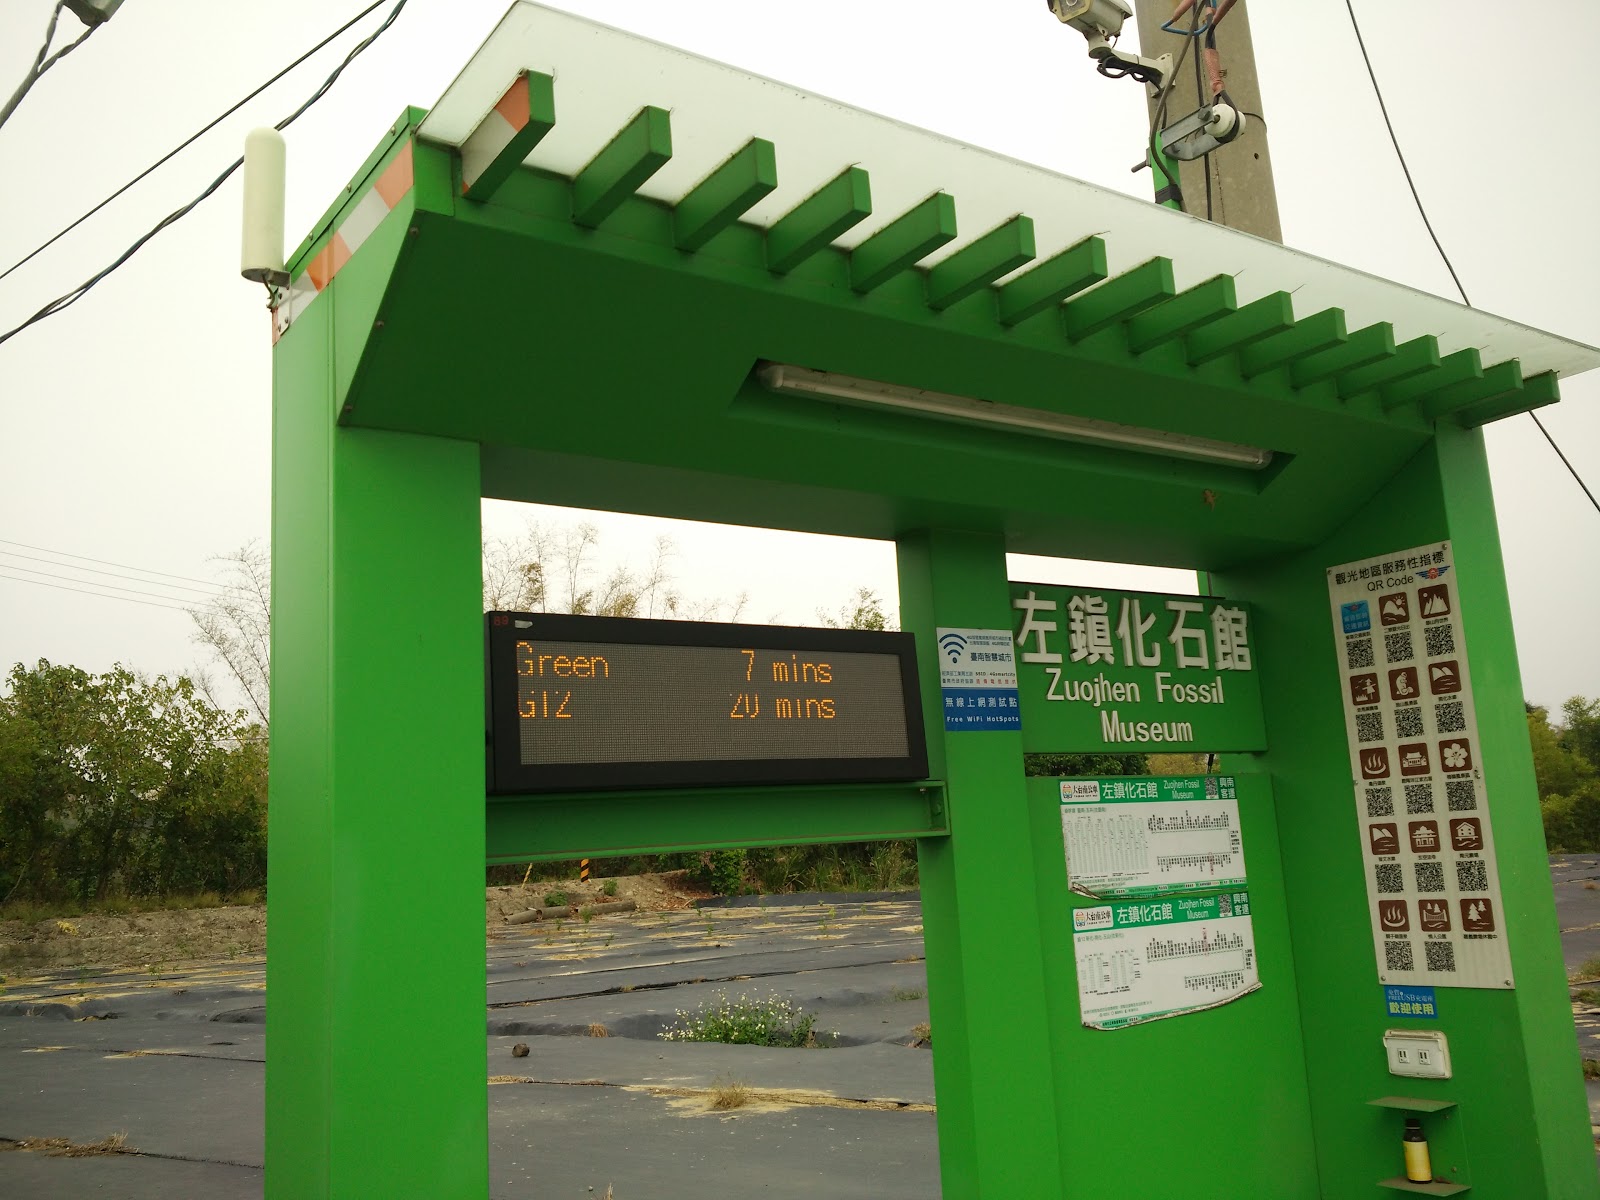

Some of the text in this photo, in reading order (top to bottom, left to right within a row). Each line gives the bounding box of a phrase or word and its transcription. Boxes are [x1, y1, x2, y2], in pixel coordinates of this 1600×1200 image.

[1335, 551, 1445, 585] 觀光地區服務性指標
[1367, 575, 1414, 592] QR Code
[1013, 590, 1252, 670] 左鎮化石館
[517, 642, 832, 682] Green 7 mins
[970, 652, 1012, 662] 臺南智慧城市
[1045, 668, 1224, 707] Zuojhen Fossil
[776, 698, 836, 718] mins
[945, 697, 1017, 708] 無線上網測試點
[1101, 710, 1193, 743] Museum
[1102, 782, 1158, 799] 左鎮化石館
[1163, 780, 1200, 792] Zuojhen Fossil
[1220, 787, 1236, 799] 客運
[1171, 790, 1195, 800] Museum
[1178, 898, 1215, 910] Zuojhen Fossil
[1117, 903, 1173, 924] 左鎮化石館
[1187, 909, 1209, 920] Museum
[1389, 1002, 1434, 1015] 歡迎使用
